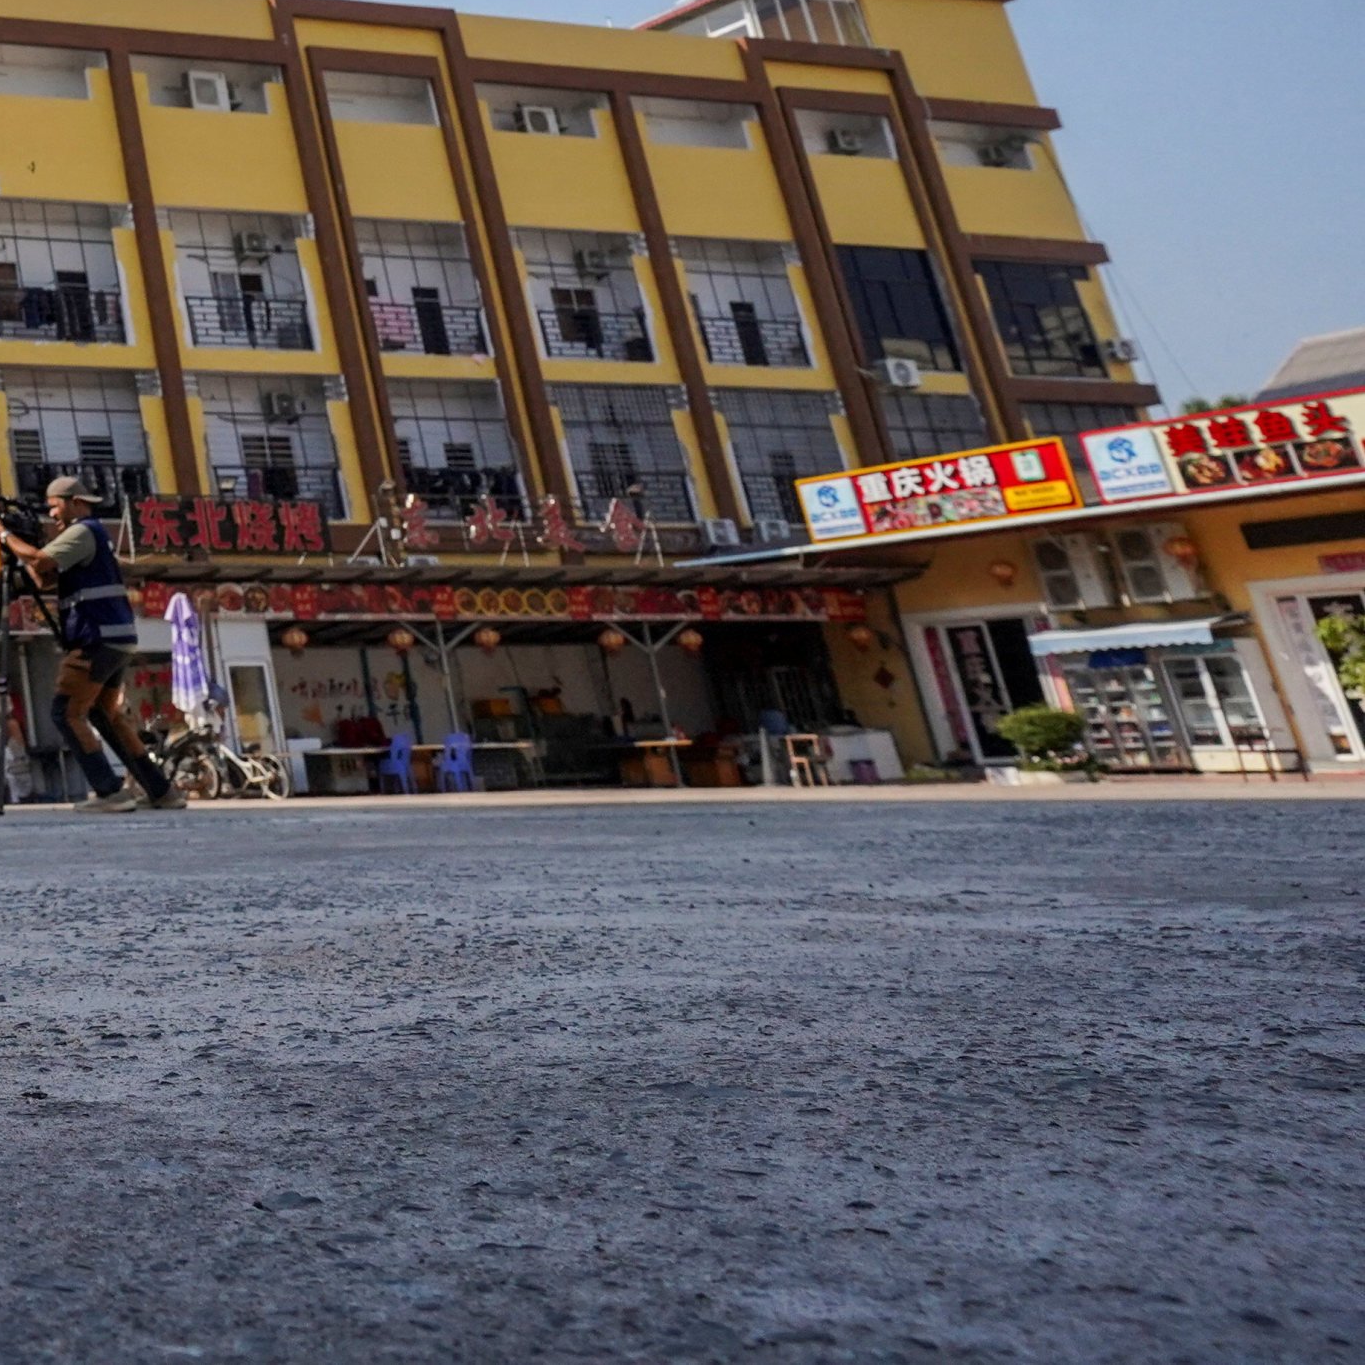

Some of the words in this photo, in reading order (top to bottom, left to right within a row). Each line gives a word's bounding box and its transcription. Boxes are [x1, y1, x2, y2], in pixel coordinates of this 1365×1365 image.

[856, 454, 996, 504] 重庆火锅
[135, 495, 325, 550] 东北烧烤
